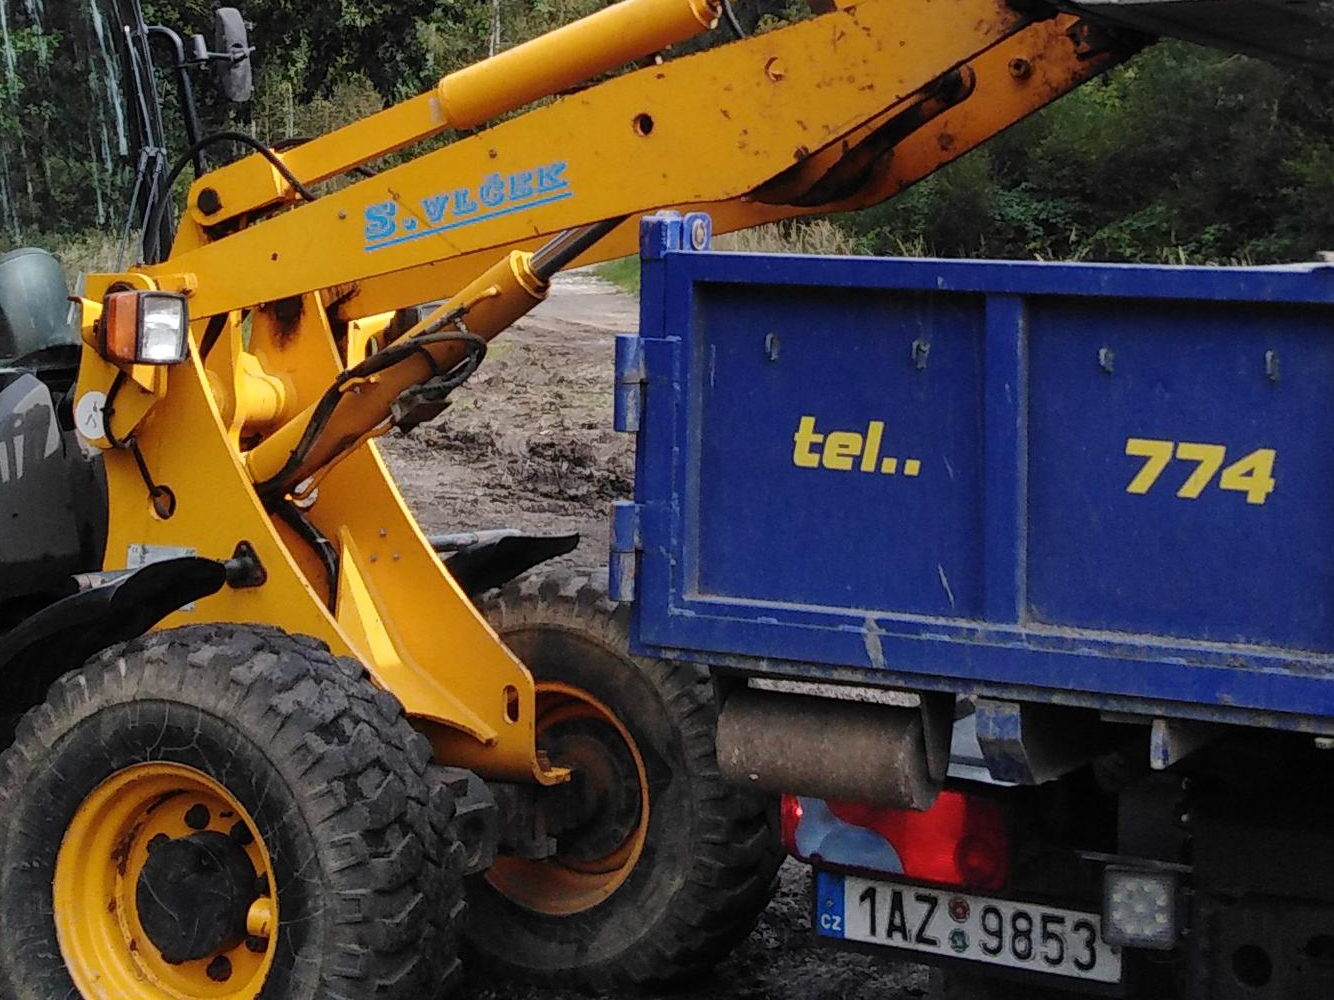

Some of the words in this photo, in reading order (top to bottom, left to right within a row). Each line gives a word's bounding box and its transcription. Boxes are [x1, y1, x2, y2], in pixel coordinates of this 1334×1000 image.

[793, 416, 921, 477] tel..
[1125, 438, 1276, 504] 774
[821, 913, 841, 931] CZ
[859, 887, 939, 947] 1AZ
[981, 904, 1097, 971] 9853
